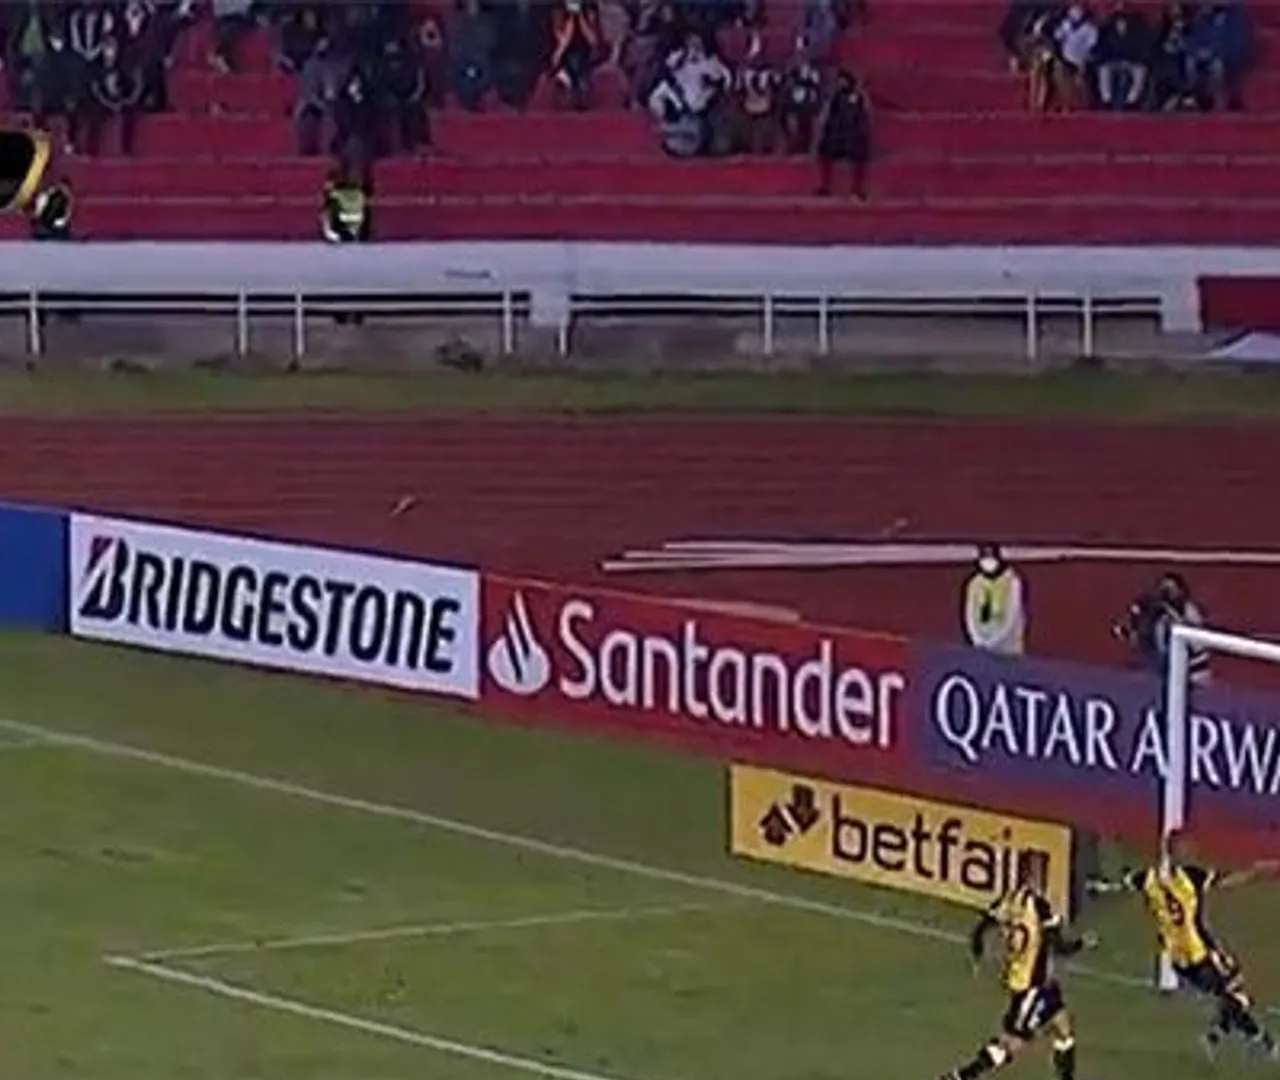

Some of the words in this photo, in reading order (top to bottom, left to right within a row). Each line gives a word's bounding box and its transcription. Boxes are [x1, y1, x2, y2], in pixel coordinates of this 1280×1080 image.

[79, 535, 462, 674] BRIDGESTONE
[558, 599, 906, 749] Santander
[936, 674, 1119, 770] QATAR
[831, 793, 1050, 897] betfai
